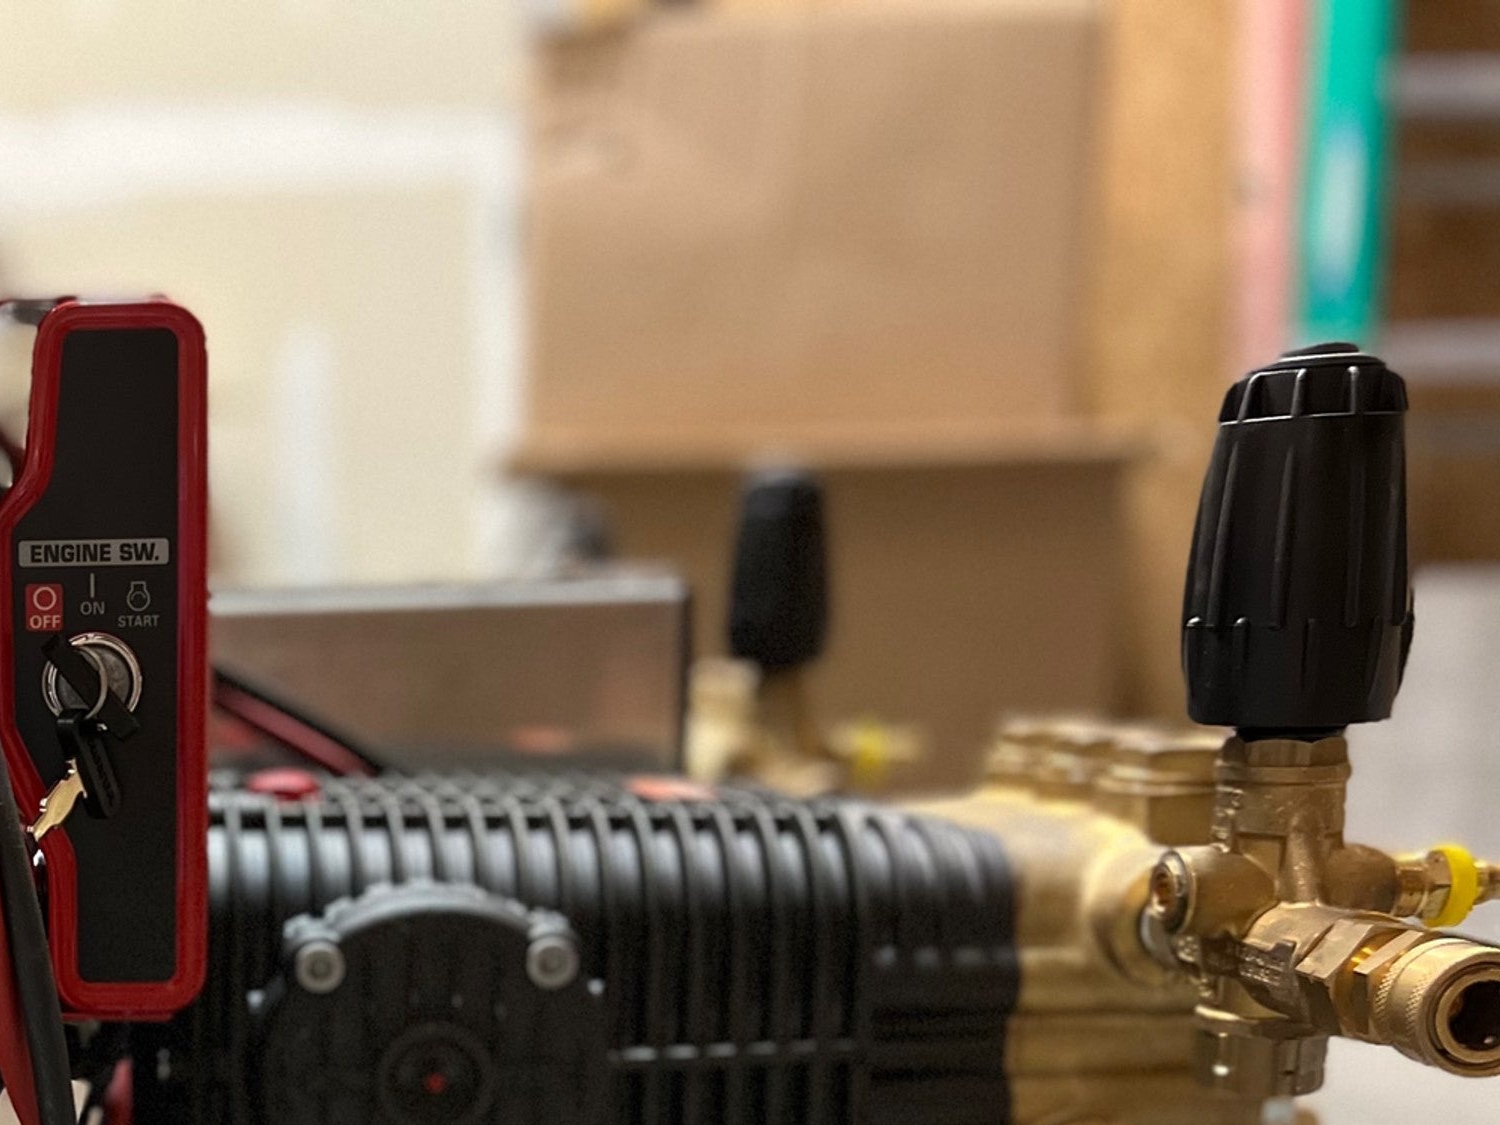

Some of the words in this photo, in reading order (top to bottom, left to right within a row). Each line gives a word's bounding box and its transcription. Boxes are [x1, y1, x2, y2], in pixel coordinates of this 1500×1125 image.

[30, 543, 112, 563] ENGINE
[118, 542, 160, 562] SW.
[80, 601, 106, 615] ON
[29, 614, 61, 630] OFF
[117, 613, 160, 628] START
